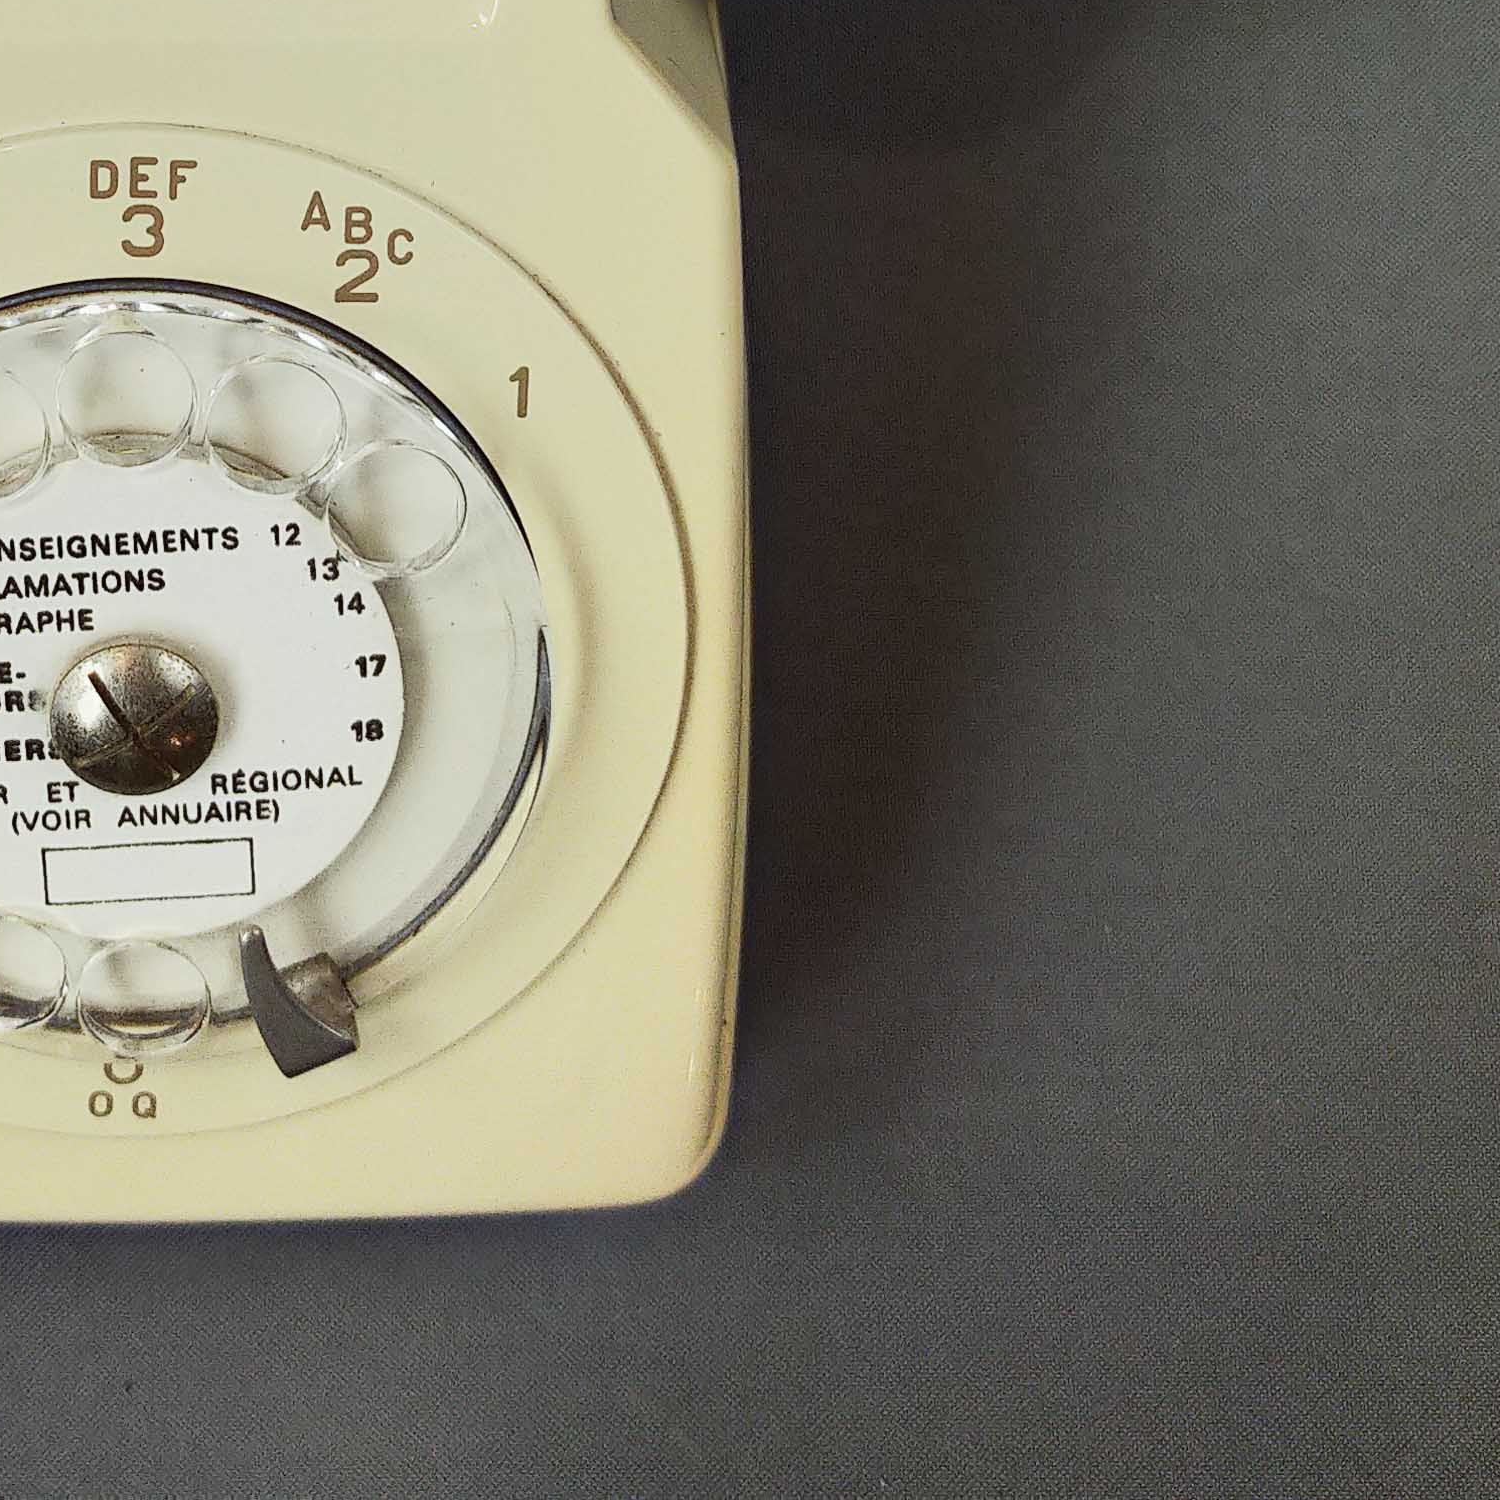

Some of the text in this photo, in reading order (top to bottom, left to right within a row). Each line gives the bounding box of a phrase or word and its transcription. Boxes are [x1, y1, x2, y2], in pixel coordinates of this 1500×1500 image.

[90, 156, 198, 201] DEF
[120, 204, 165, 258] 3
[333, 248, 380, 304] 2
[508, 366, 531, 419] 1
[270, 522, 302, 547] 12
[306, 556, 341, 581] 13
[333, 591, 366, 616] 14
[354, 653, 387, 678] 17
[350, 718, 385, 743] 18
[46, 781, 80, 804] ET
[210, 764, 364, 797] RÉGIONAL
[10, 798, 281, 836] (VOIR ANNUAIRE)
